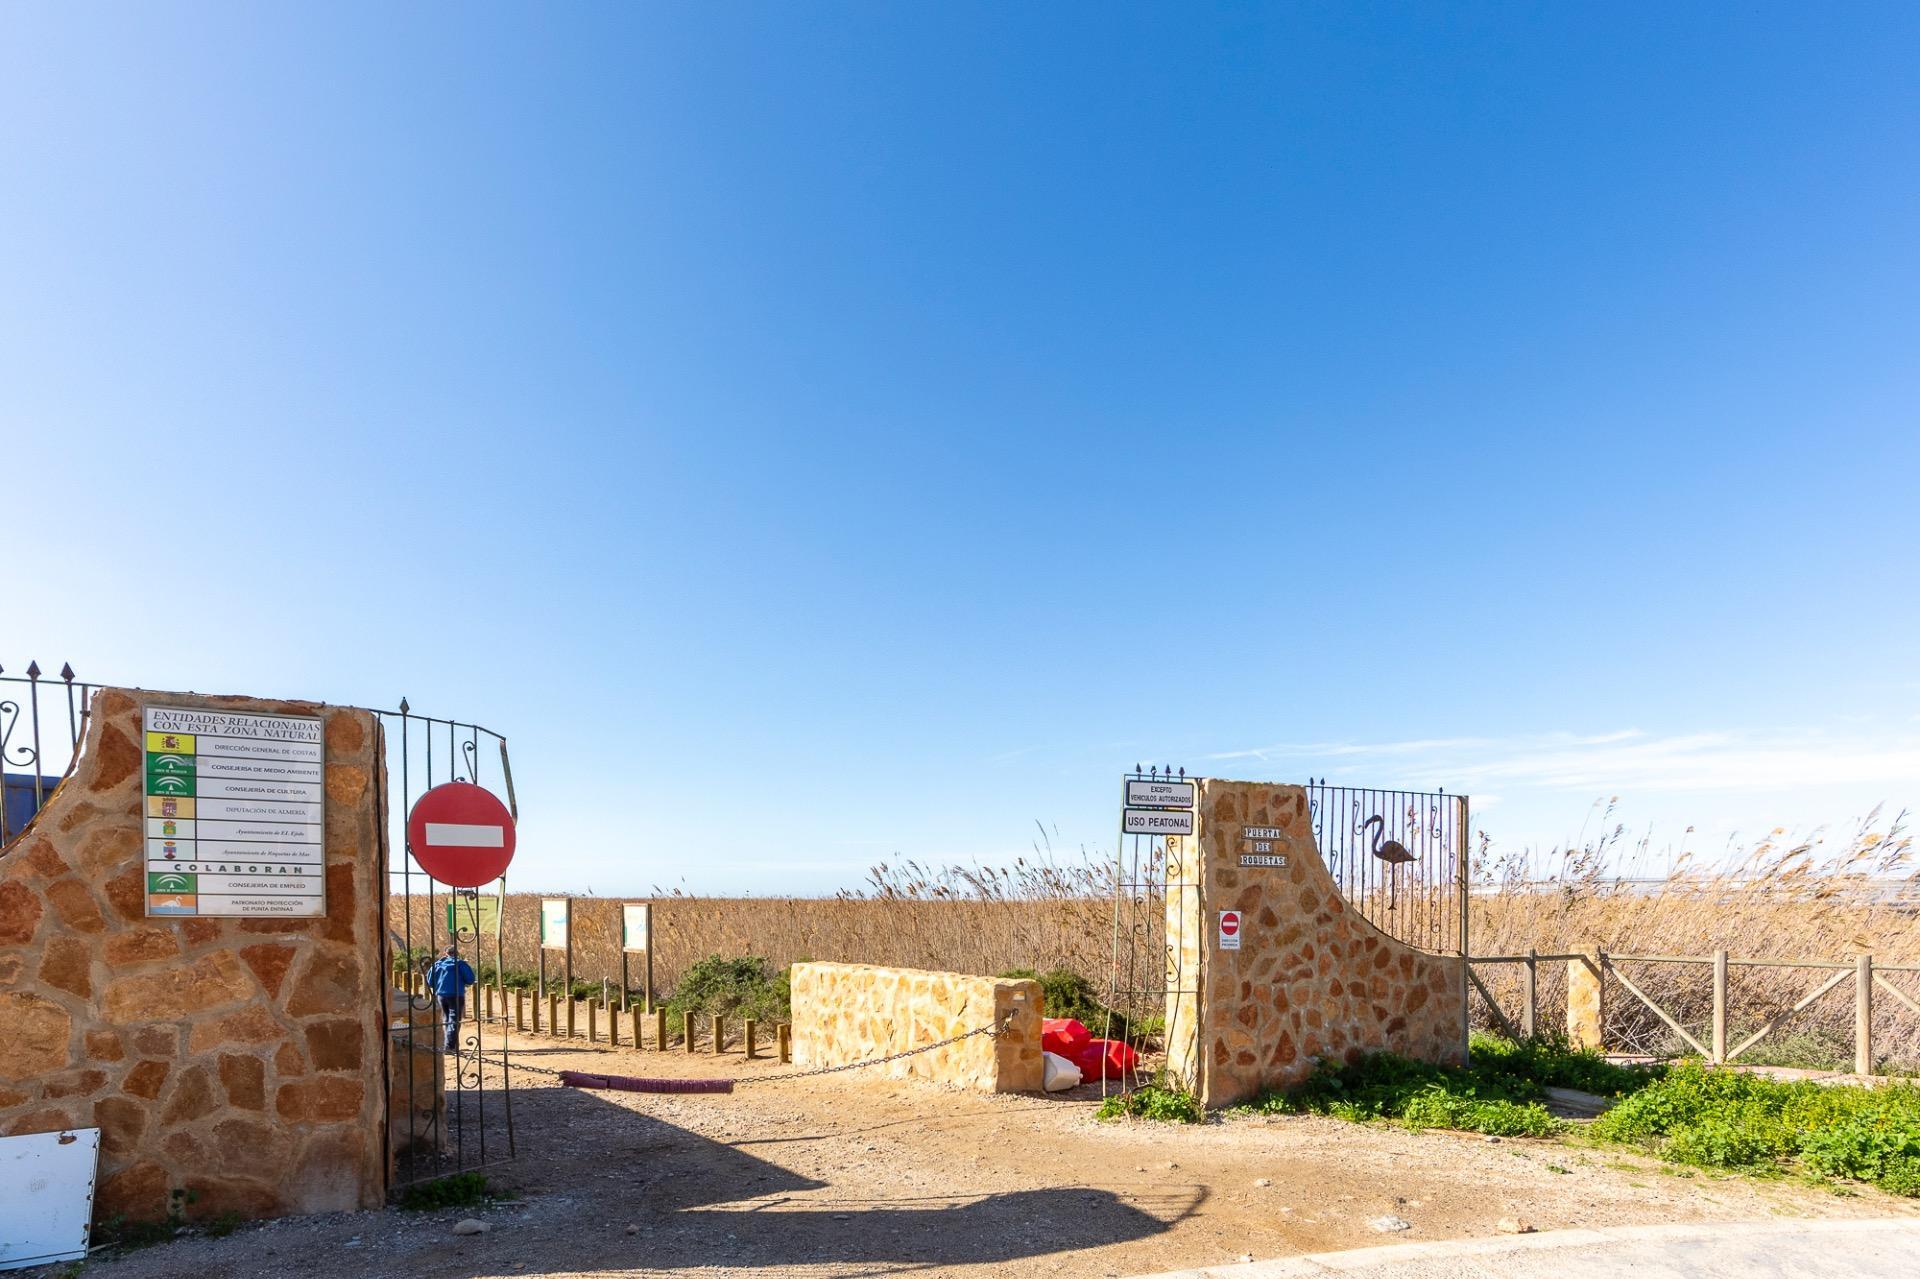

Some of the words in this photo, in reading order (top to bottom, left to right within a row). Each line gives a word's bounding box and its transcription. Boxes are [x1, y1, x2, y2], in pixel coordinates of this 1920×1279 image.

[153, 711, 226, 725] ENTIDADES
[228, 717, 320, 732] RELACIONADAS
[153, 720, 180, 731] CON
[187, 723, 217, 733] ESTA
[224, 726, 258, 736] ZONA
[264, 729, 318, 740] NATURAL
[214, 744, 250, 752] DIRECCIÓN
[251, 746, 280, 754] GENERAL
[292, 749, 317, 757] COSTAS
[1150, 785, 1172, 793] EXCEPTO
[1159, 795, 1191, 803] AUTORIZADOS
[1128, 816, 1145, 826] USO
[1148, 817, 1190, 828] PEATONAL
[235, 828, 274, 836] Ayuntamiento
[1247, 828, 1279, 838] PUERTA
[1258, 842, 1269, 851] DE
[223, 849, 260, 857] Ayuntamiento
[1242, 856, 1285, 865] ROQUETAS
[174, 863, 303, 874] COLABORAN
